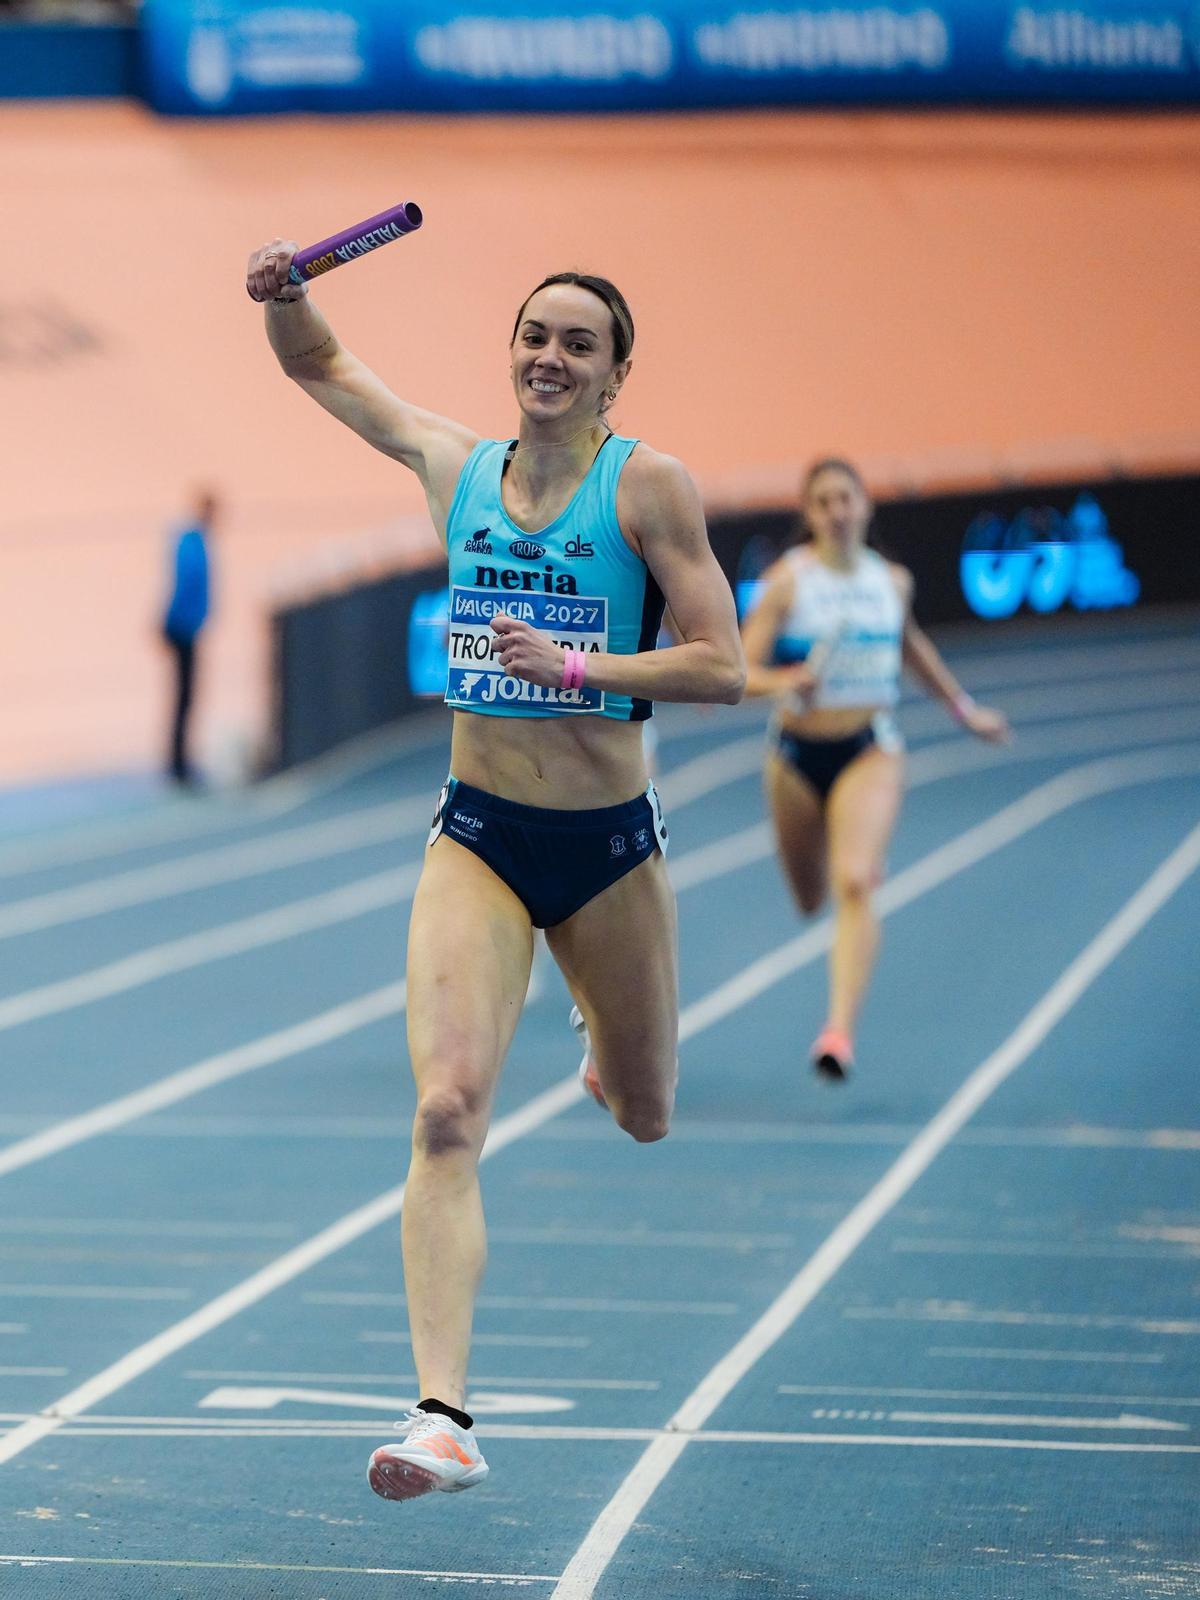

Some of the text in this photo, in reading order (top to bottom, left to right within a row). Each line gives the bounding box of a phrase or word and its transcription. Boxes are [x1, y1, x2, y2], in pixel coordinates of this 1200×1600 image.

[335, 221, 407, 260] VALENCIA
[305, 252, 339, 276] 2008
[511, 541, 544, 556] TROPS
[564, 534, 594, 557] als
[455, 596, 599, 624] VALENCIA 2027
[453, 811, 483, 829] nerja
